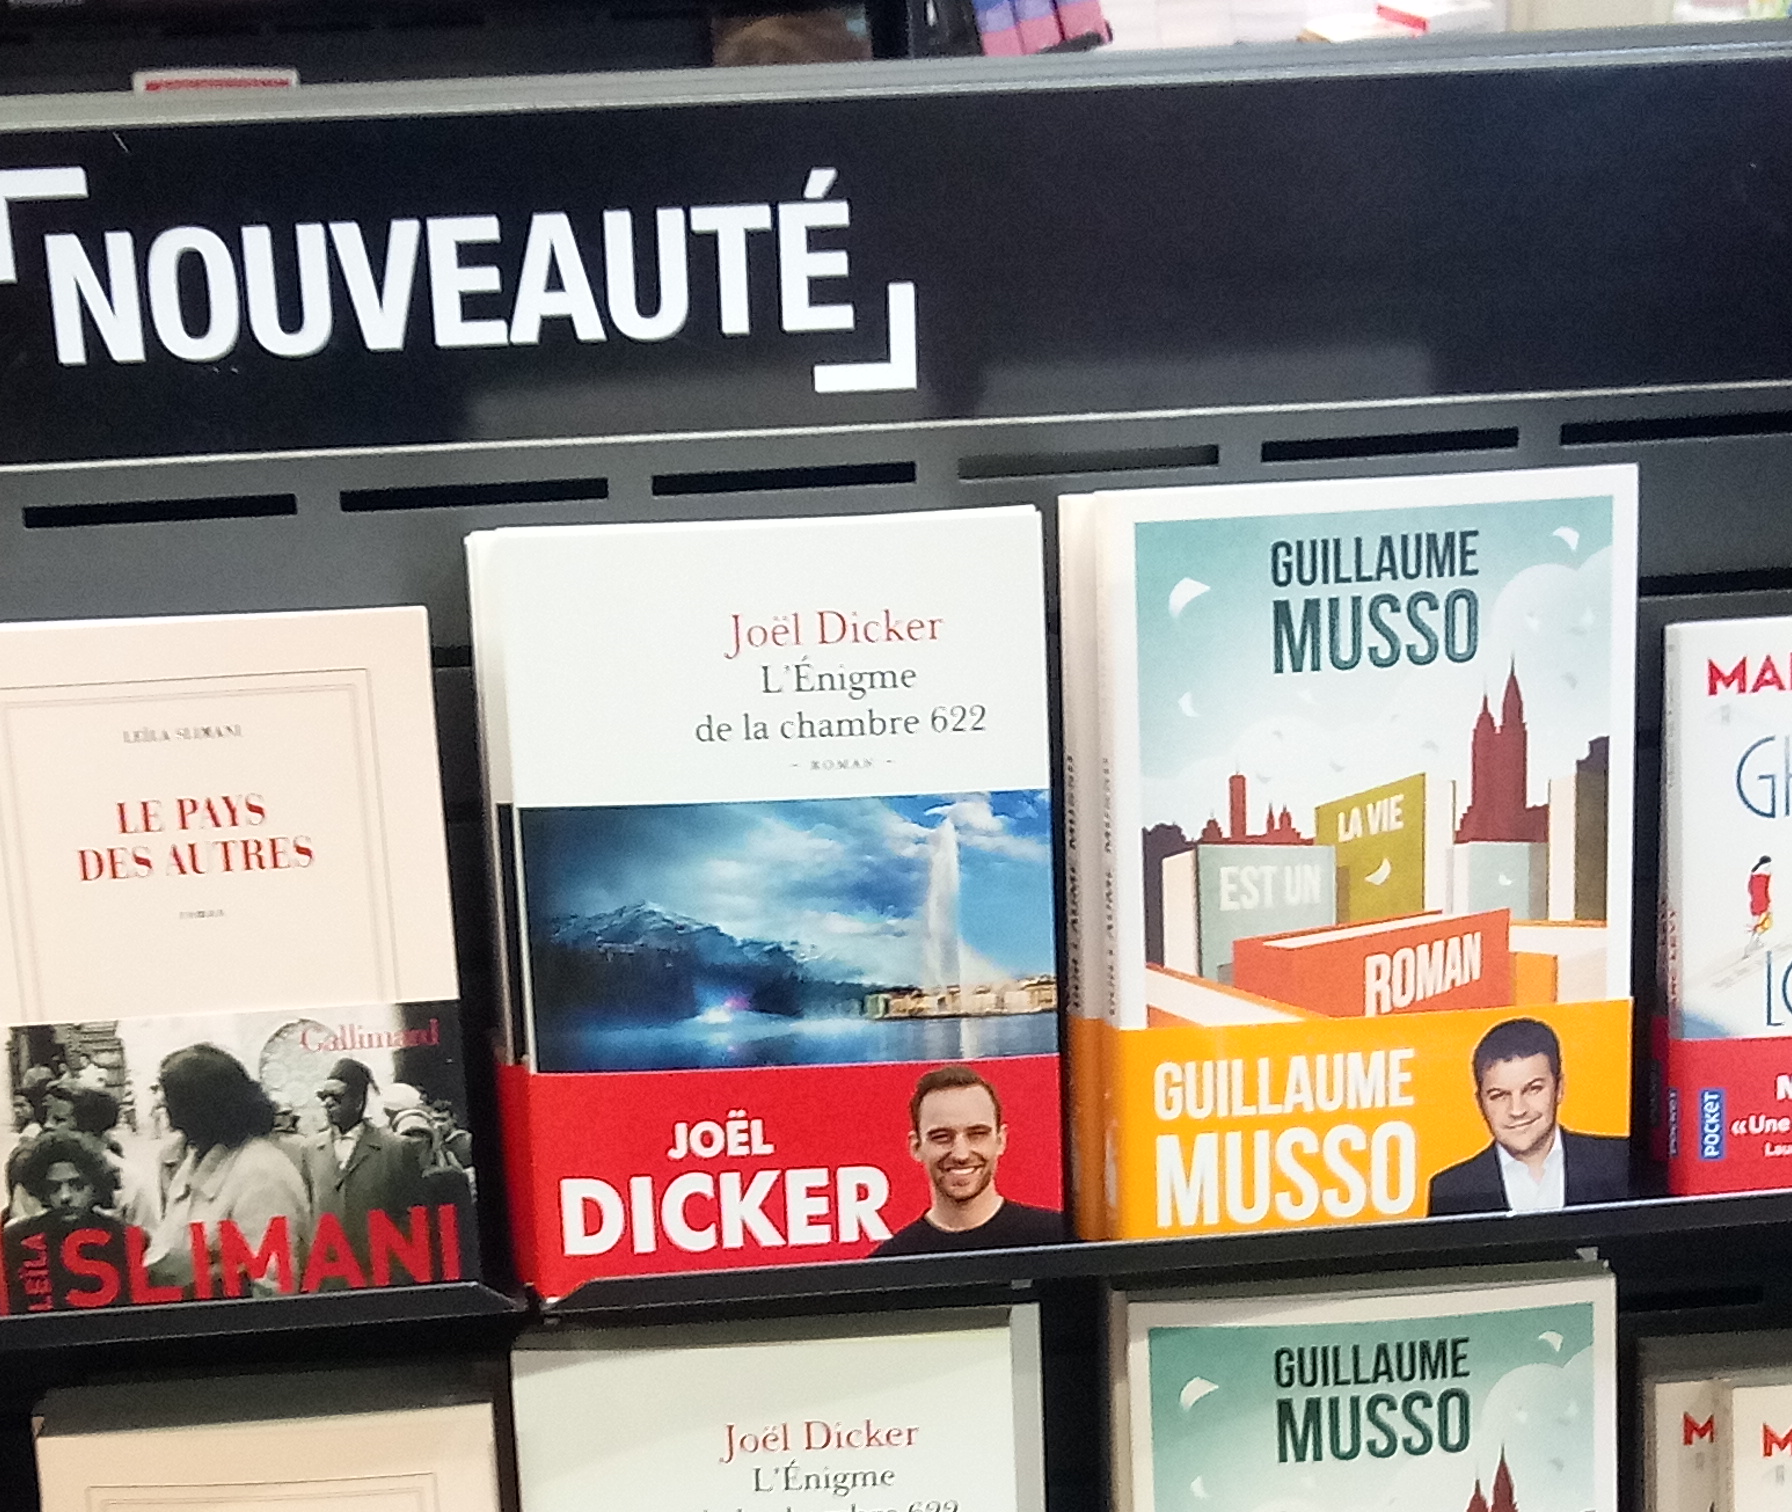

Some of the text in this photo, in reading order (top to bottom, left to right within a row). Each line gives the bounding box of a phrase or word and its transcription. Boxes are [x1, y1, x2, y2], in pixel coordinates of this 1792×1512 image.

[44, 165, 856, 365] NOUVEAUTÉ
[1270, 529, 1479, 588] GUILLAUME
[725, 610, 944, 659] Joël Dicker
[1272, 588, 1479, 674] MUSSO
[761, 656, 917, 700] L'Énigme
[696, 704, 986, 743] de la chambre 622
[116, 793, 267, 834] LE PAYS
[1338, 794, 1404, 842] LA VIE
[78, 835, 316, 883] DES AUTRES
[1219, 860, 1322, 911] EST UN
[1364, 931, 1482, 1018] ROMAN
[299, 1018, 440, 1054] Gallimard
[1153, 1048, 1416, 1121] GUILLAUME
[667, 1110, 774, 1160] JOËL
[1156, 1119, 1418, 1229] MUSSO
[558, 1165, 893, 1257] DICKER
[60, 1204, 460, 1308] SLIMANI
[1274, 1338, 1470, 1388] GUILLAUME
[720, 1420, 919, 1464] Joël Dicker
[1276, 1388, 1470, 1463] MUSSO
